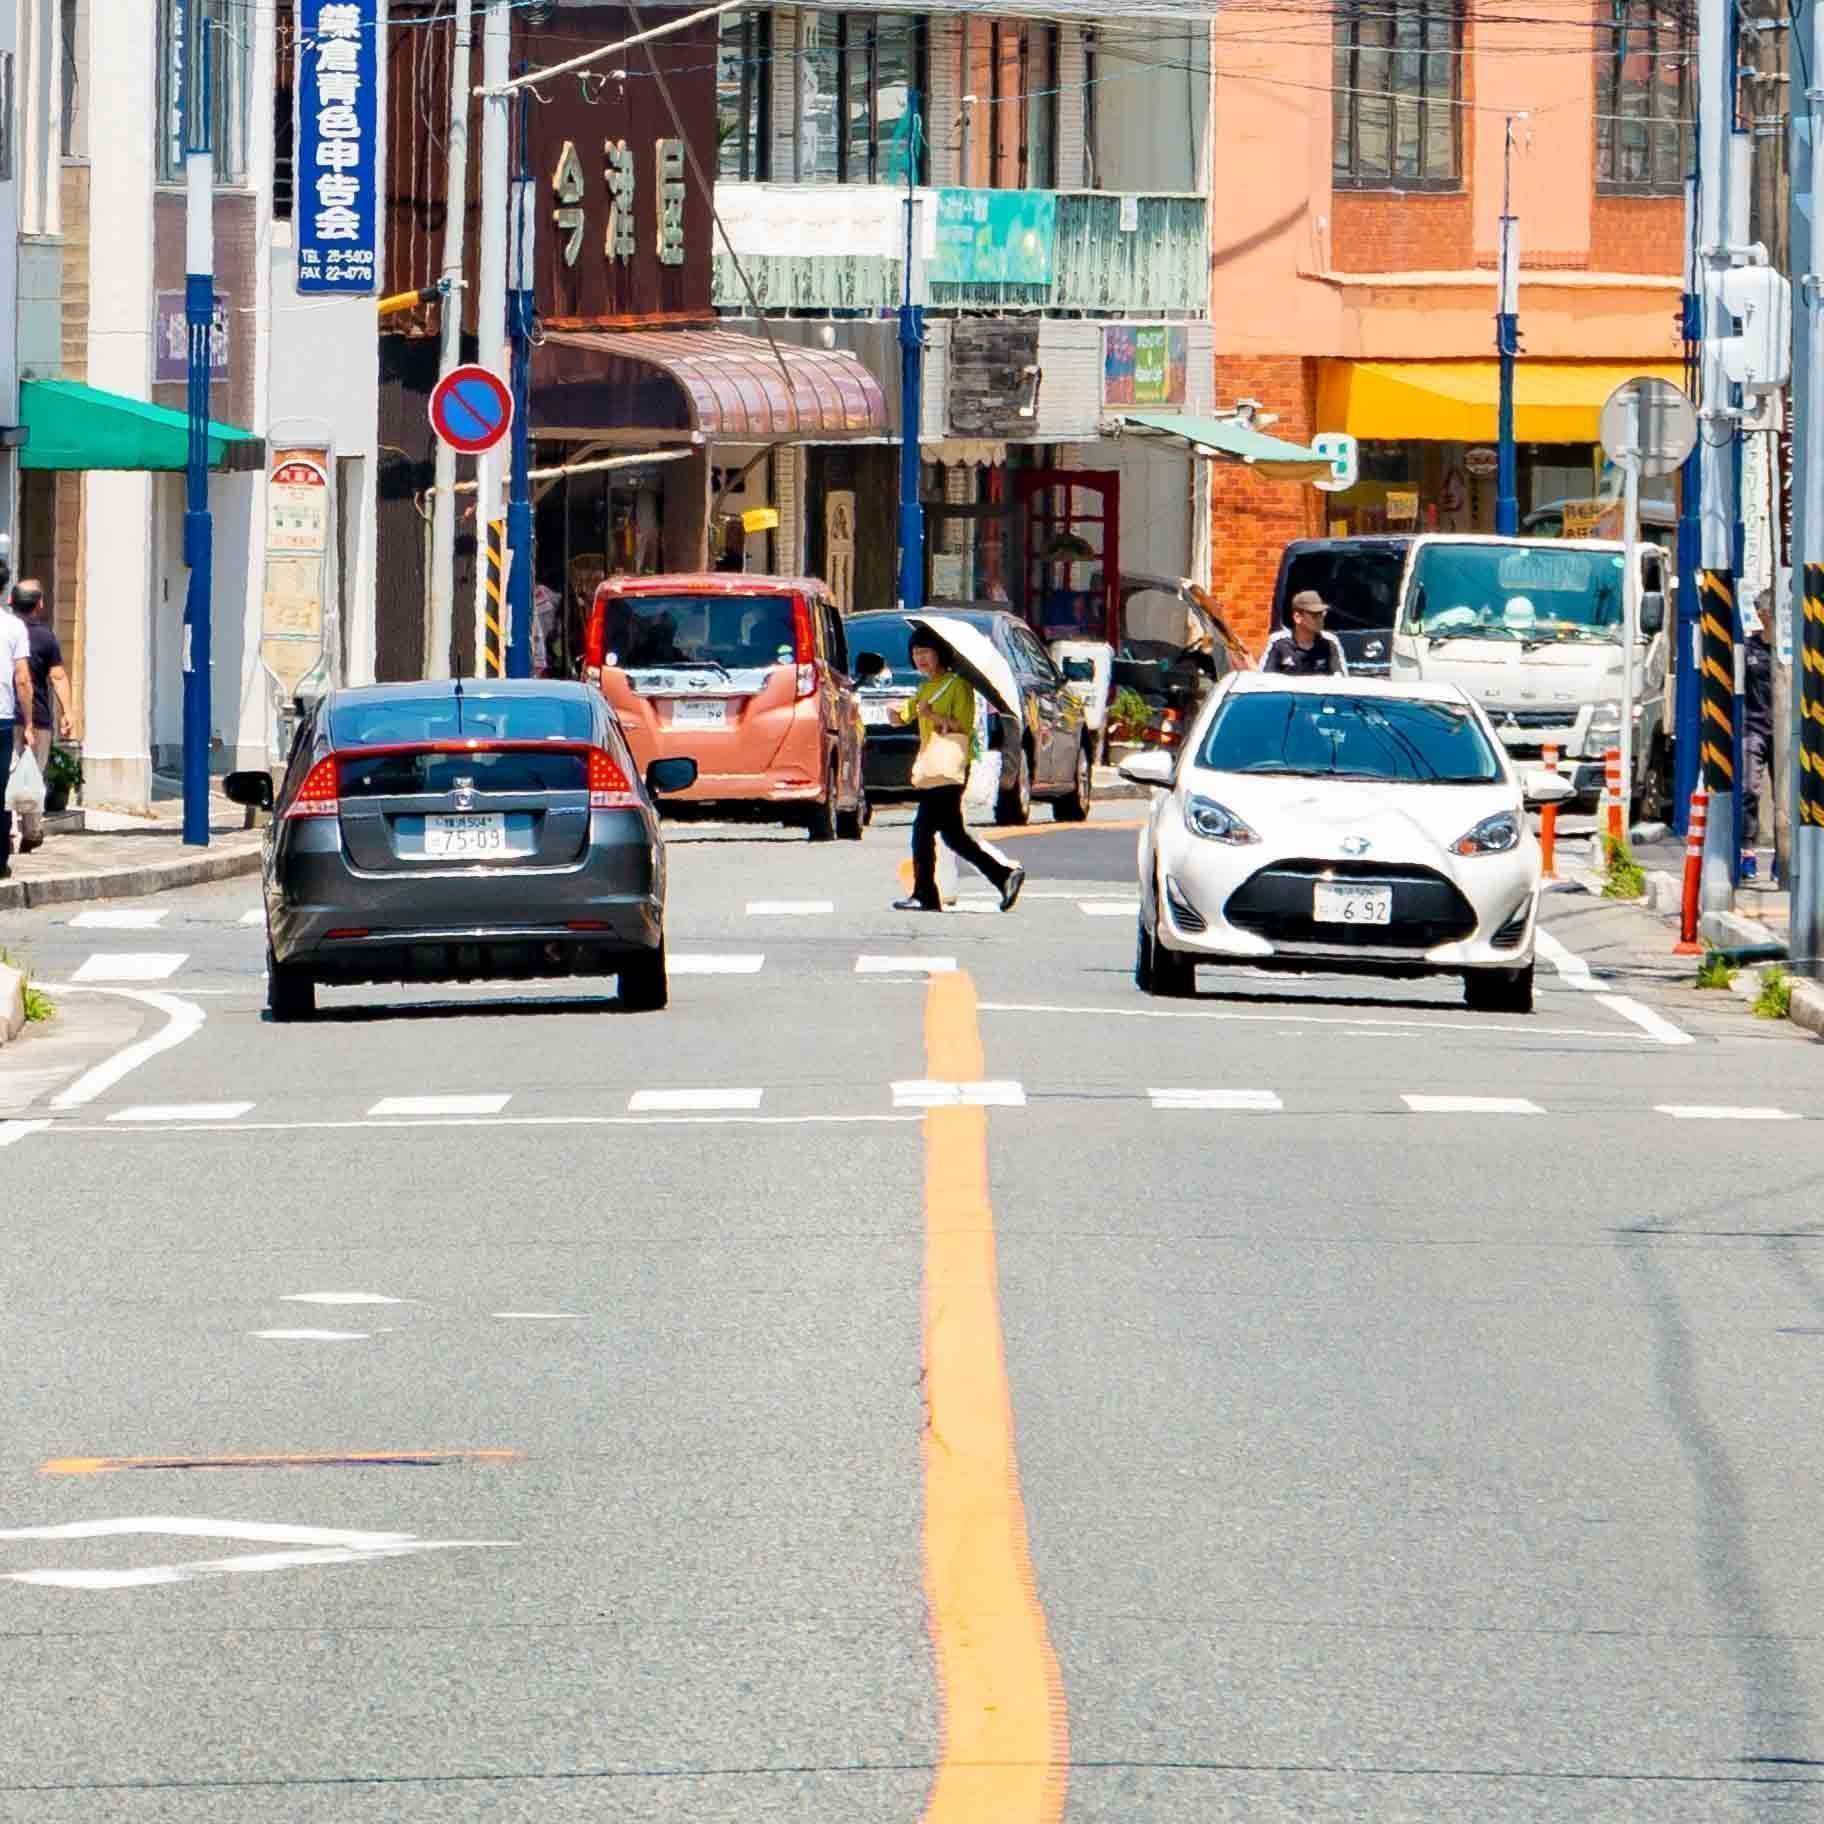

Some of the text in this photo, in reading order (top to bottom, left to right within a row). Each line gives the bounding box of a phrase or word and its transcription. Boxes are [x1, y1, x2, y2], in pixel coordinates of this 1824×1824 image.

[314, 3, 363, 241] 鎌倉青色申告会
[301, 249, 321, 263] TEL
[300, 266, 321, 279] FAX
[444, 829, 501, 851] 75-09
